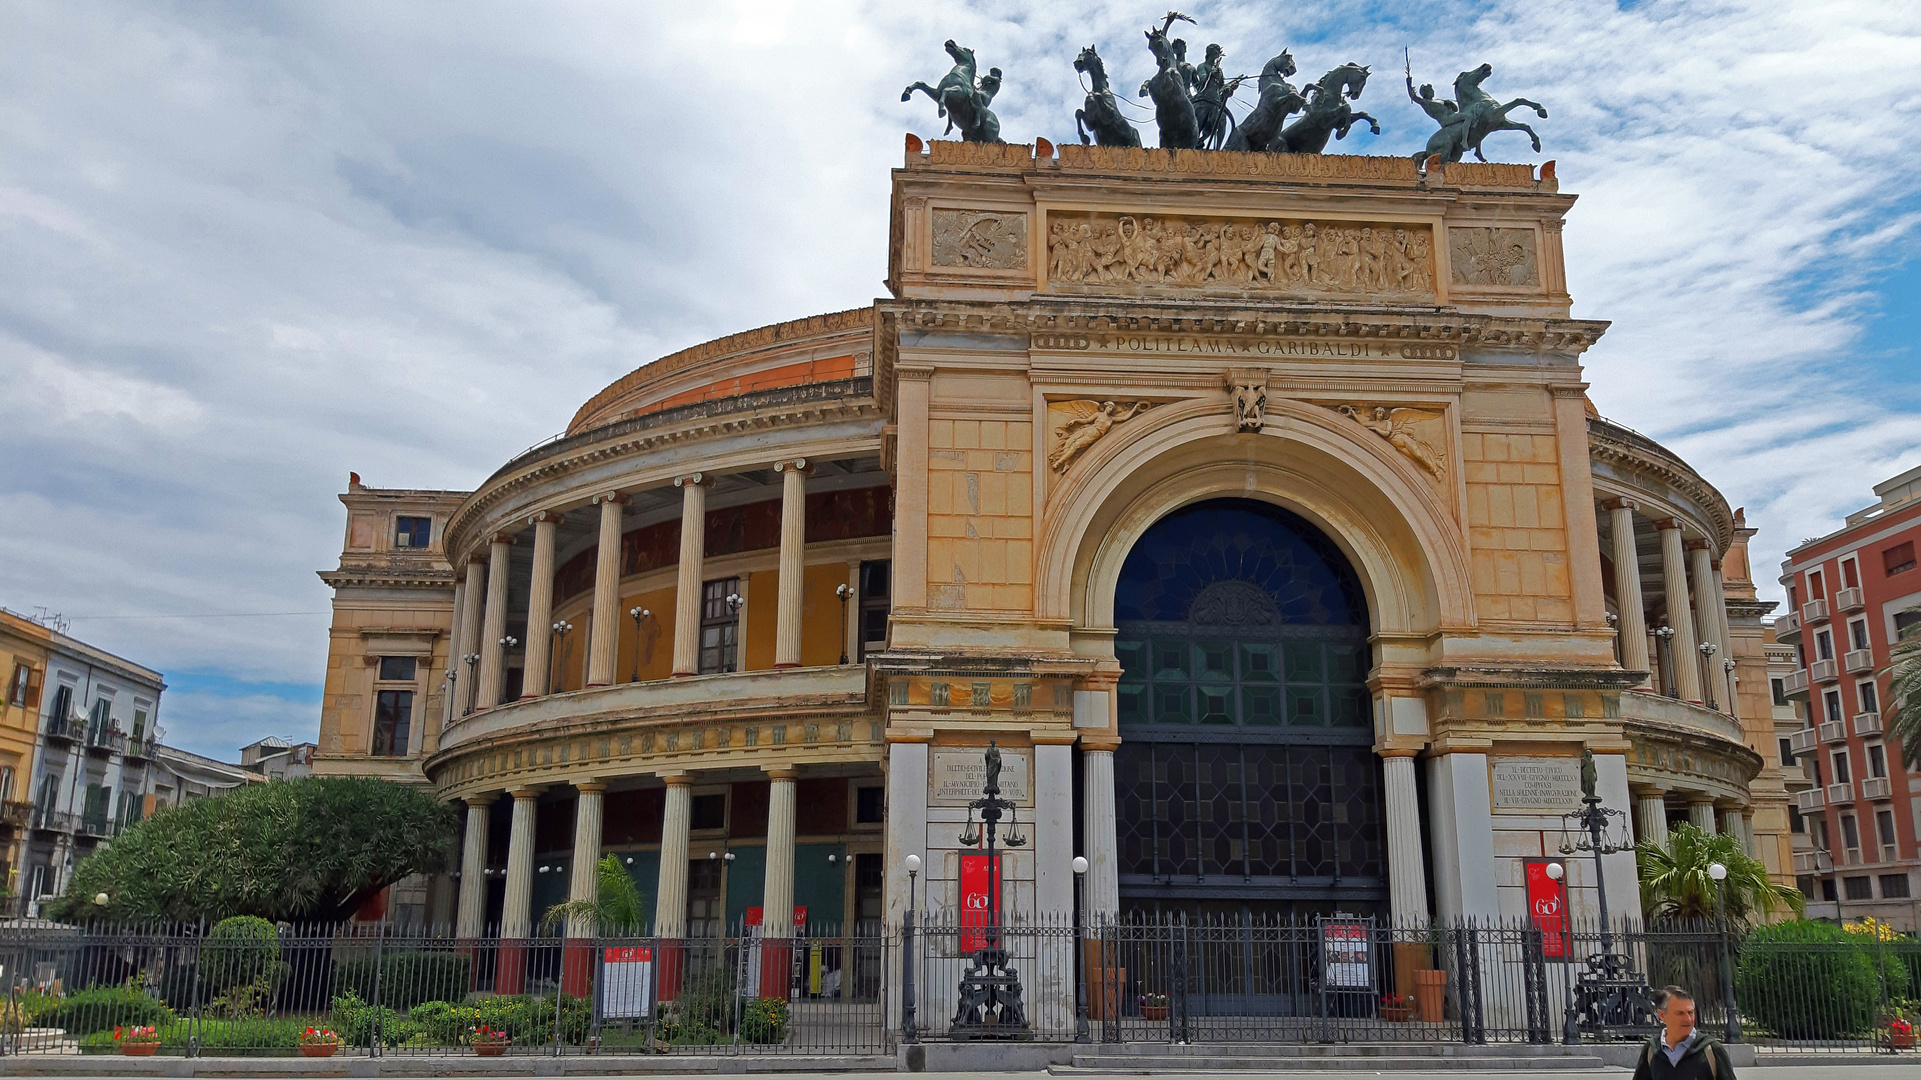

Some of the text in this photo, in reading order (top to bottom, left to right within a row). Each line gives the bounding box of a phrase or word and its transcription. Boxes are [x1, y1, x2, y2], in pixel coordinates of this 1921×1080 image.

[1116, 336, 1370, 357] POLITEAMA GARIBALDI
[967, 892, 989, 909] 60
[1535, 898, 1557, 915] 60
